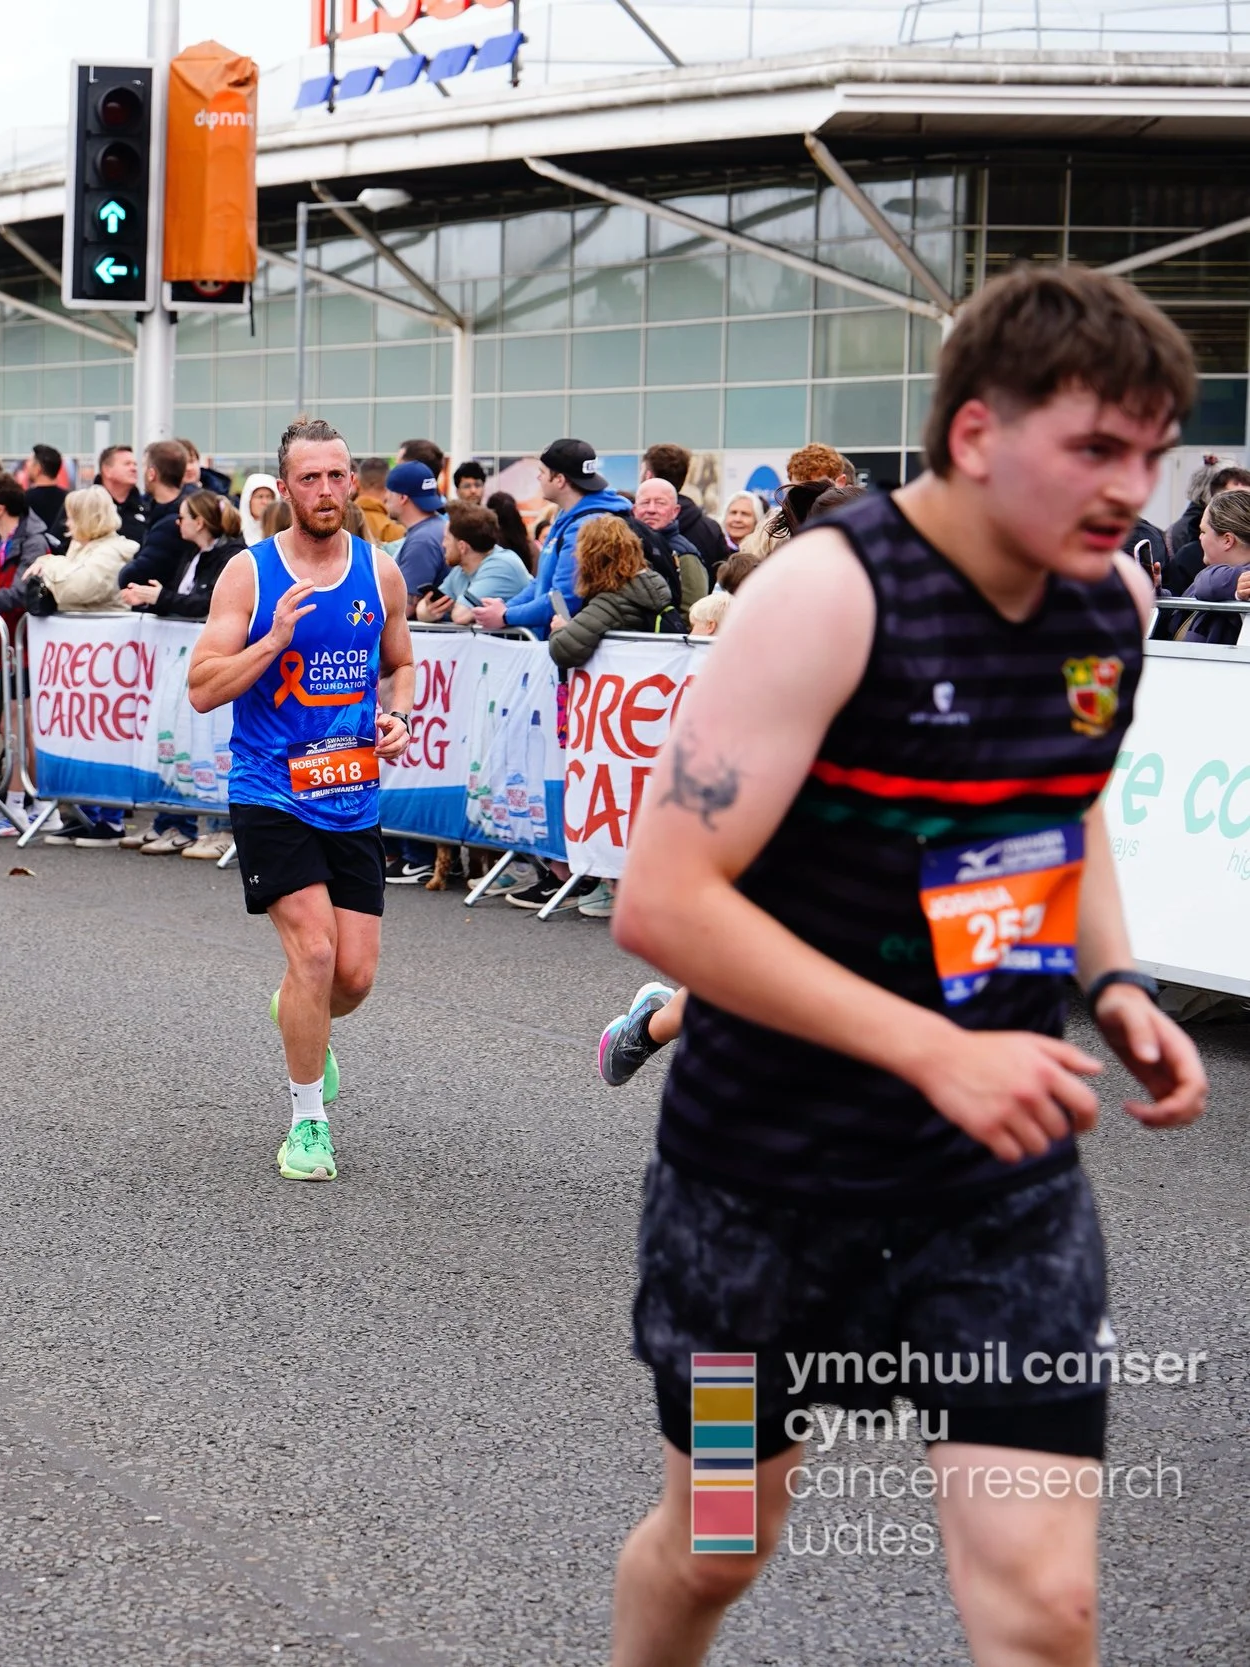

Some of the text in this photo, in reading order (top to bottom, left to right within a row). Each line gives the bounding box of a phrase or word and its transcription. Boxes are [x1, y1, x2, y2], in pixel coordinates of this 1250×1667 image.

[38, 640, 157, 691] BRECON
[309, 649, 368, 666] JACOB
[309, 664, 367, 681] CRANE
[309, 680, 366, 691] FOUNDATION
[37, 690, 152, 742] CARREG
[567, 668, 696, 760] BRE
[326, 736, 357, 744] SWANSEA
[291, 756, 330, 771] ROBERT
[308, 761, 362, 786] 3618
[311, 784, 364, 798] #RUNSWANSEA
